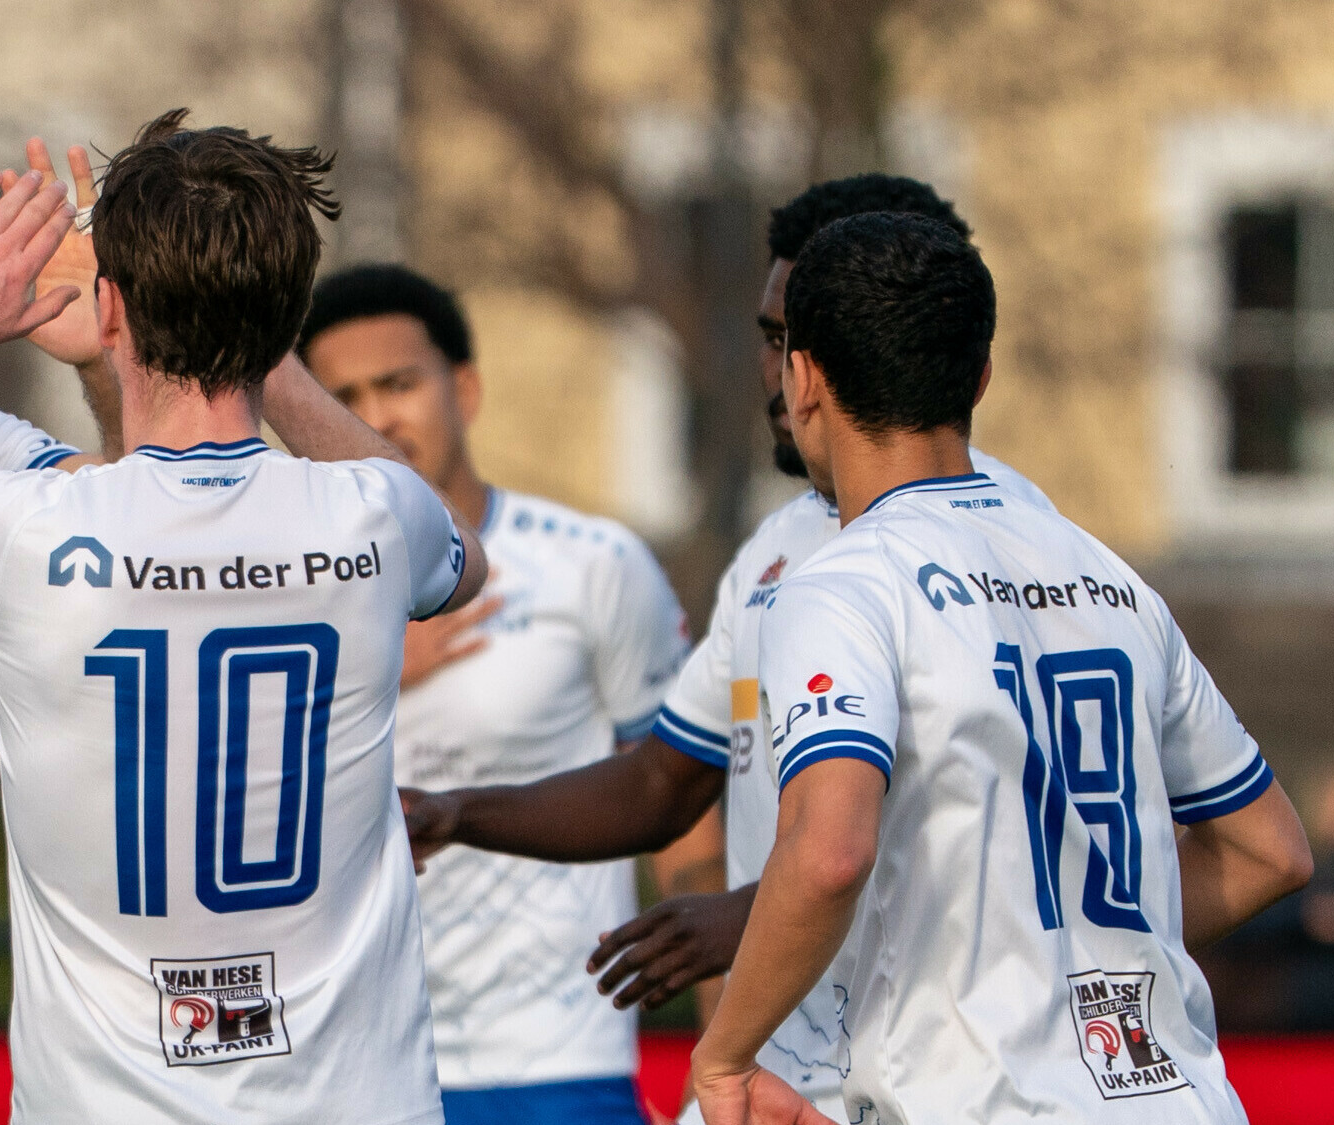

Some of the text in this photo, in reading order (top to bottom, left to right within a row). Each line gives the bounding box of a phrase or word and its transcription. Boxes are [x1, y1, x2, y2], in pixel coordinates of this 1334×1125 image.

[123, 541, 382, 591] Van der Poel
[967, 572, 1021, 608] Van
[1022, 578, 1078, 610] der
[84, 621, 341, 918] 10
[161, 964, 263, 989] VAN HESE
[172, 1035, 275, 1059] UK-PAINT
[1101, 1061, 1178, 1090] UK-PAIN
